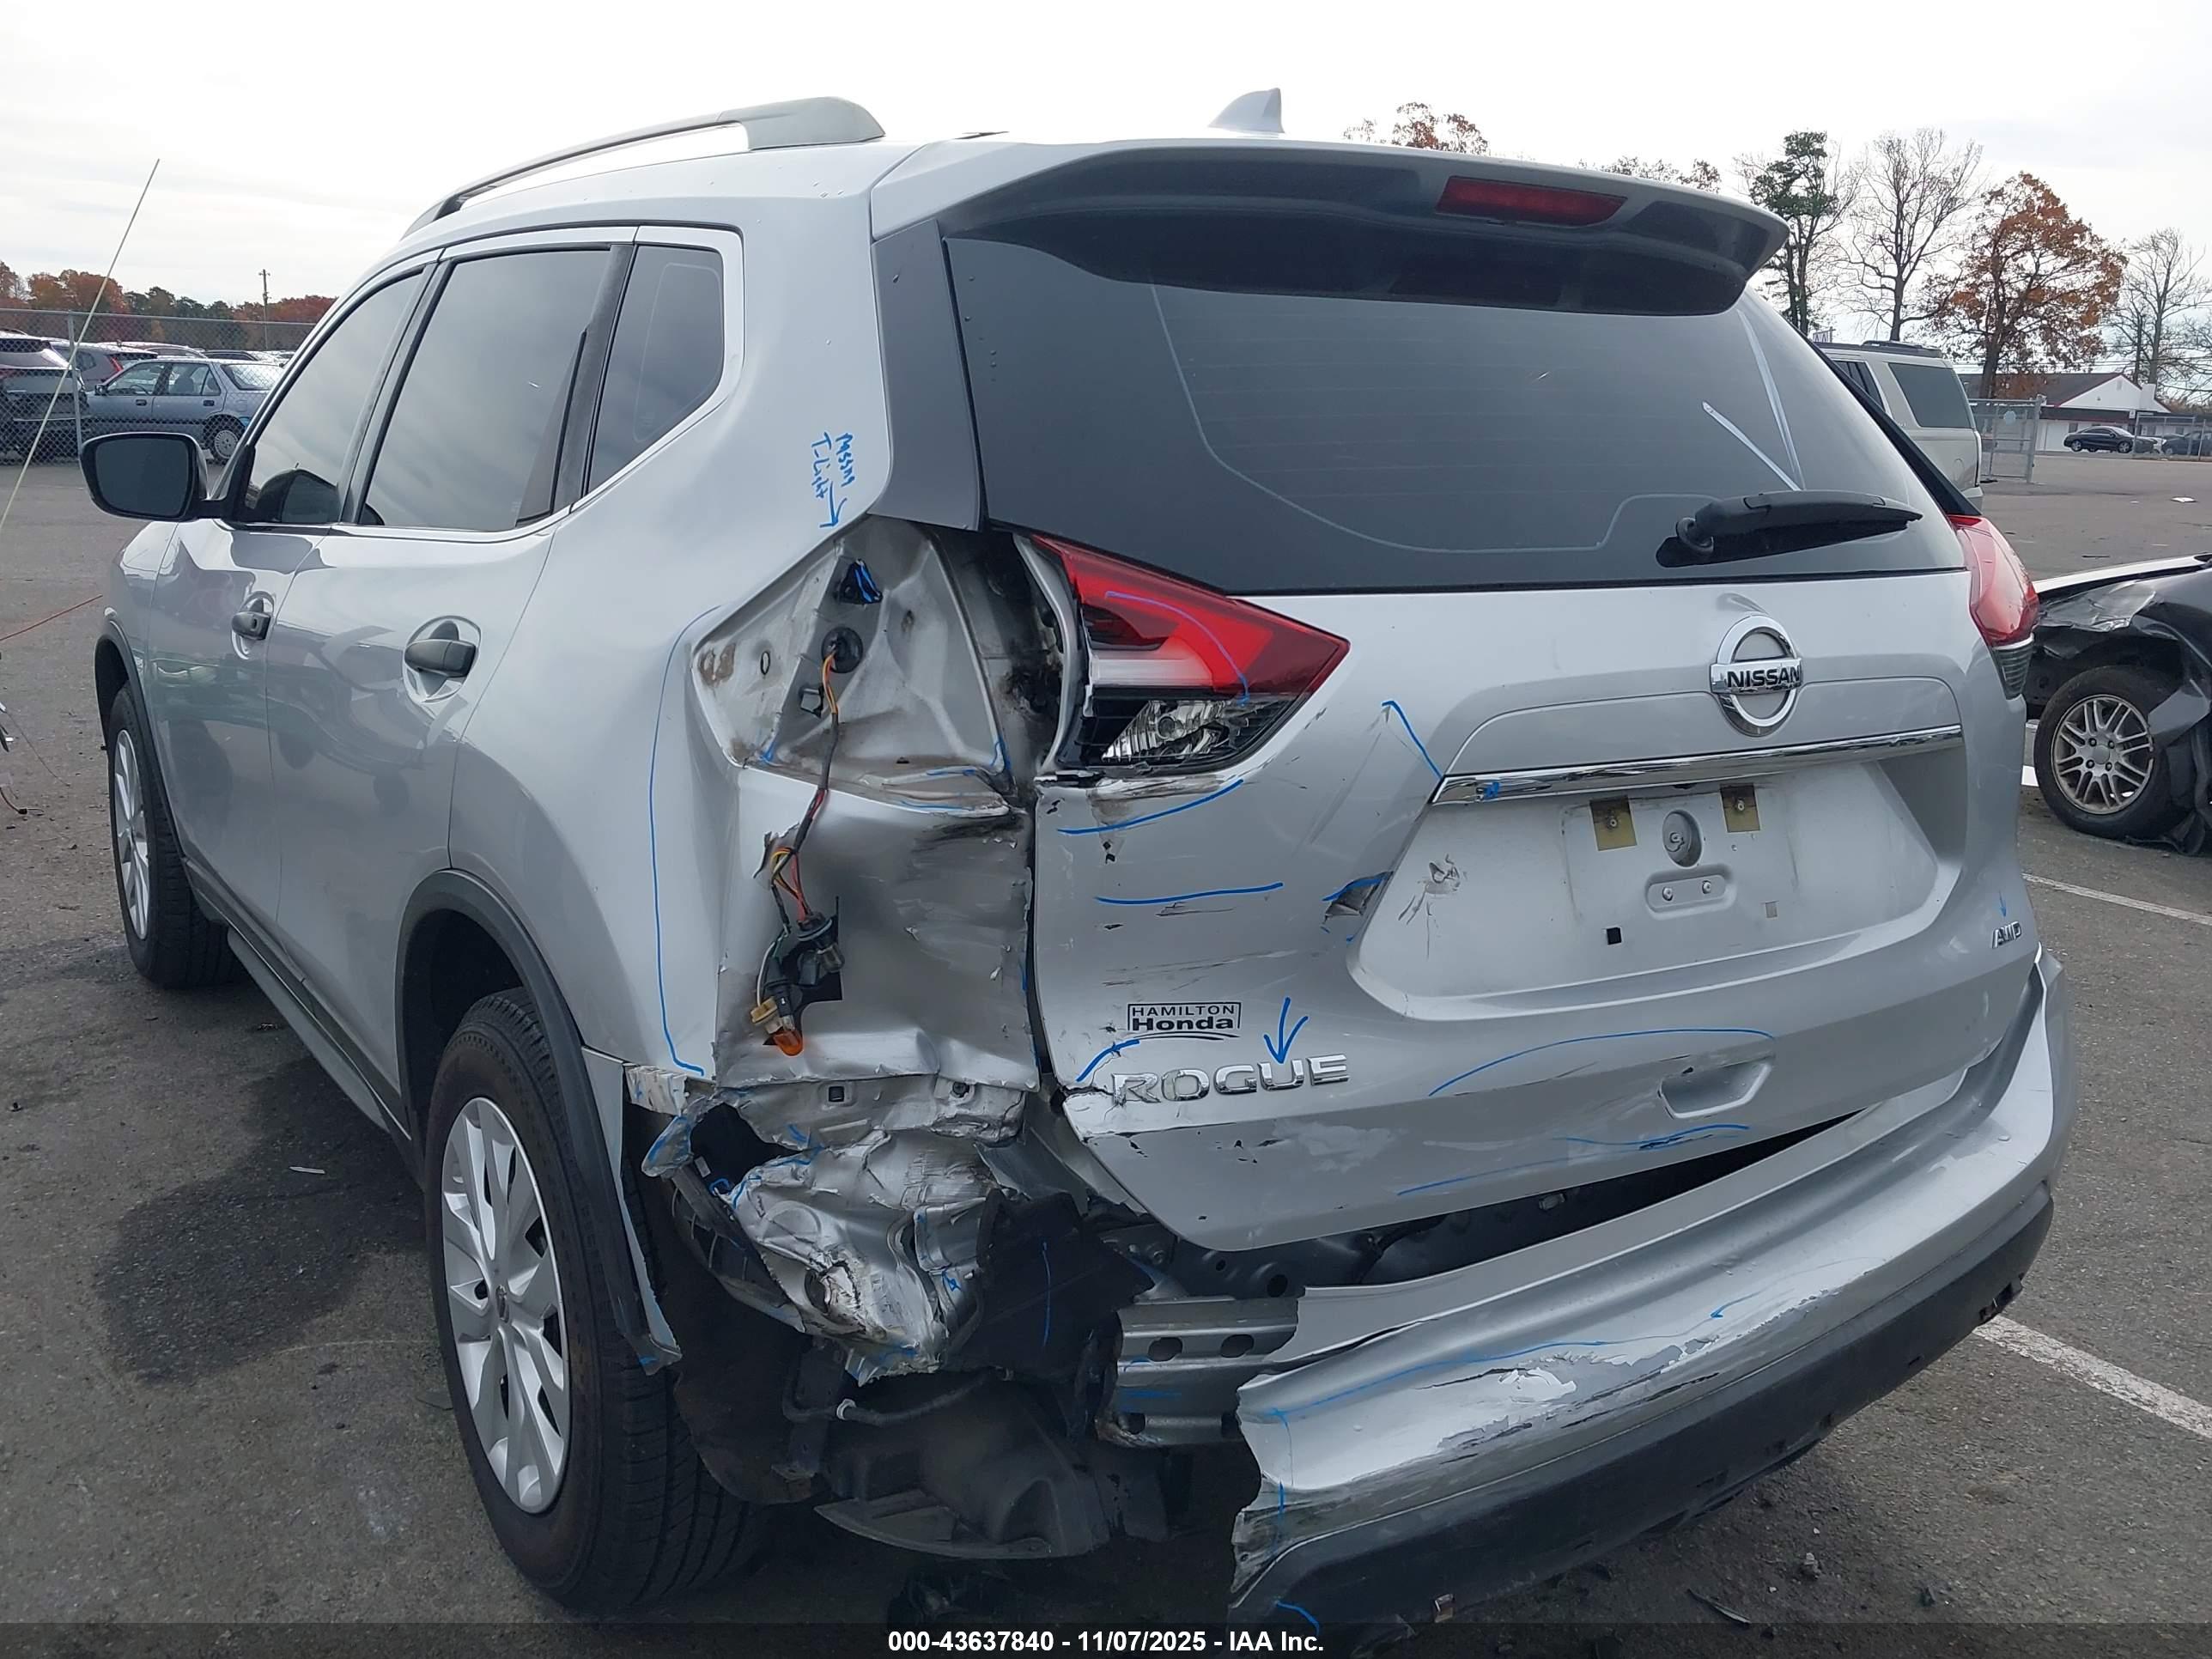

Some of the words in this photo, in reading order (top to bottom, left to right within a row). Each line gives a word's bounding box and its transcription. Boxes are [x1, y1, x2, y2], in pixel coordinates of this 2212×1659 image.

[1727, 665, 1801, 688] NISSAN
[1992, 921, 2022, 950] AWD
[1132, 1005, 1235, 1017] HAMILTON
[1132, 1017, 1234, 1031] Honda
[1112, 1054, 1351, 1104] ROGUE
